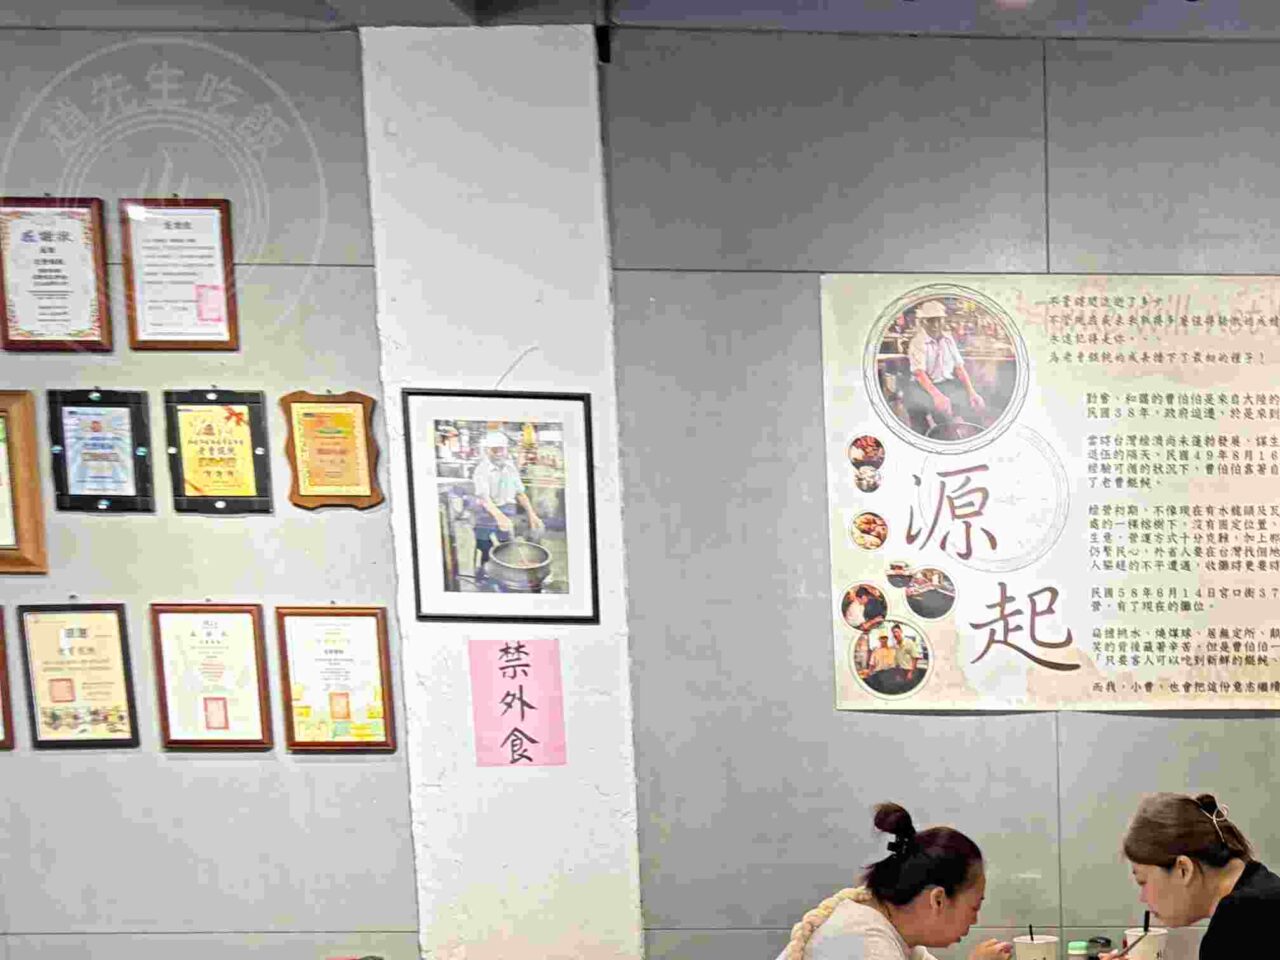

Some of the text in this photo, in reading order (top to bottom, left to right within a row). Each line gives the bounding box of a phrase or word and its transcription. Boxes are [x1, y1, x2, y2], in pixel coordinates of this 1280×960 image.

[905, 463, 1081, 672] 源起
[498, 640, 540, 765] 禁外食
